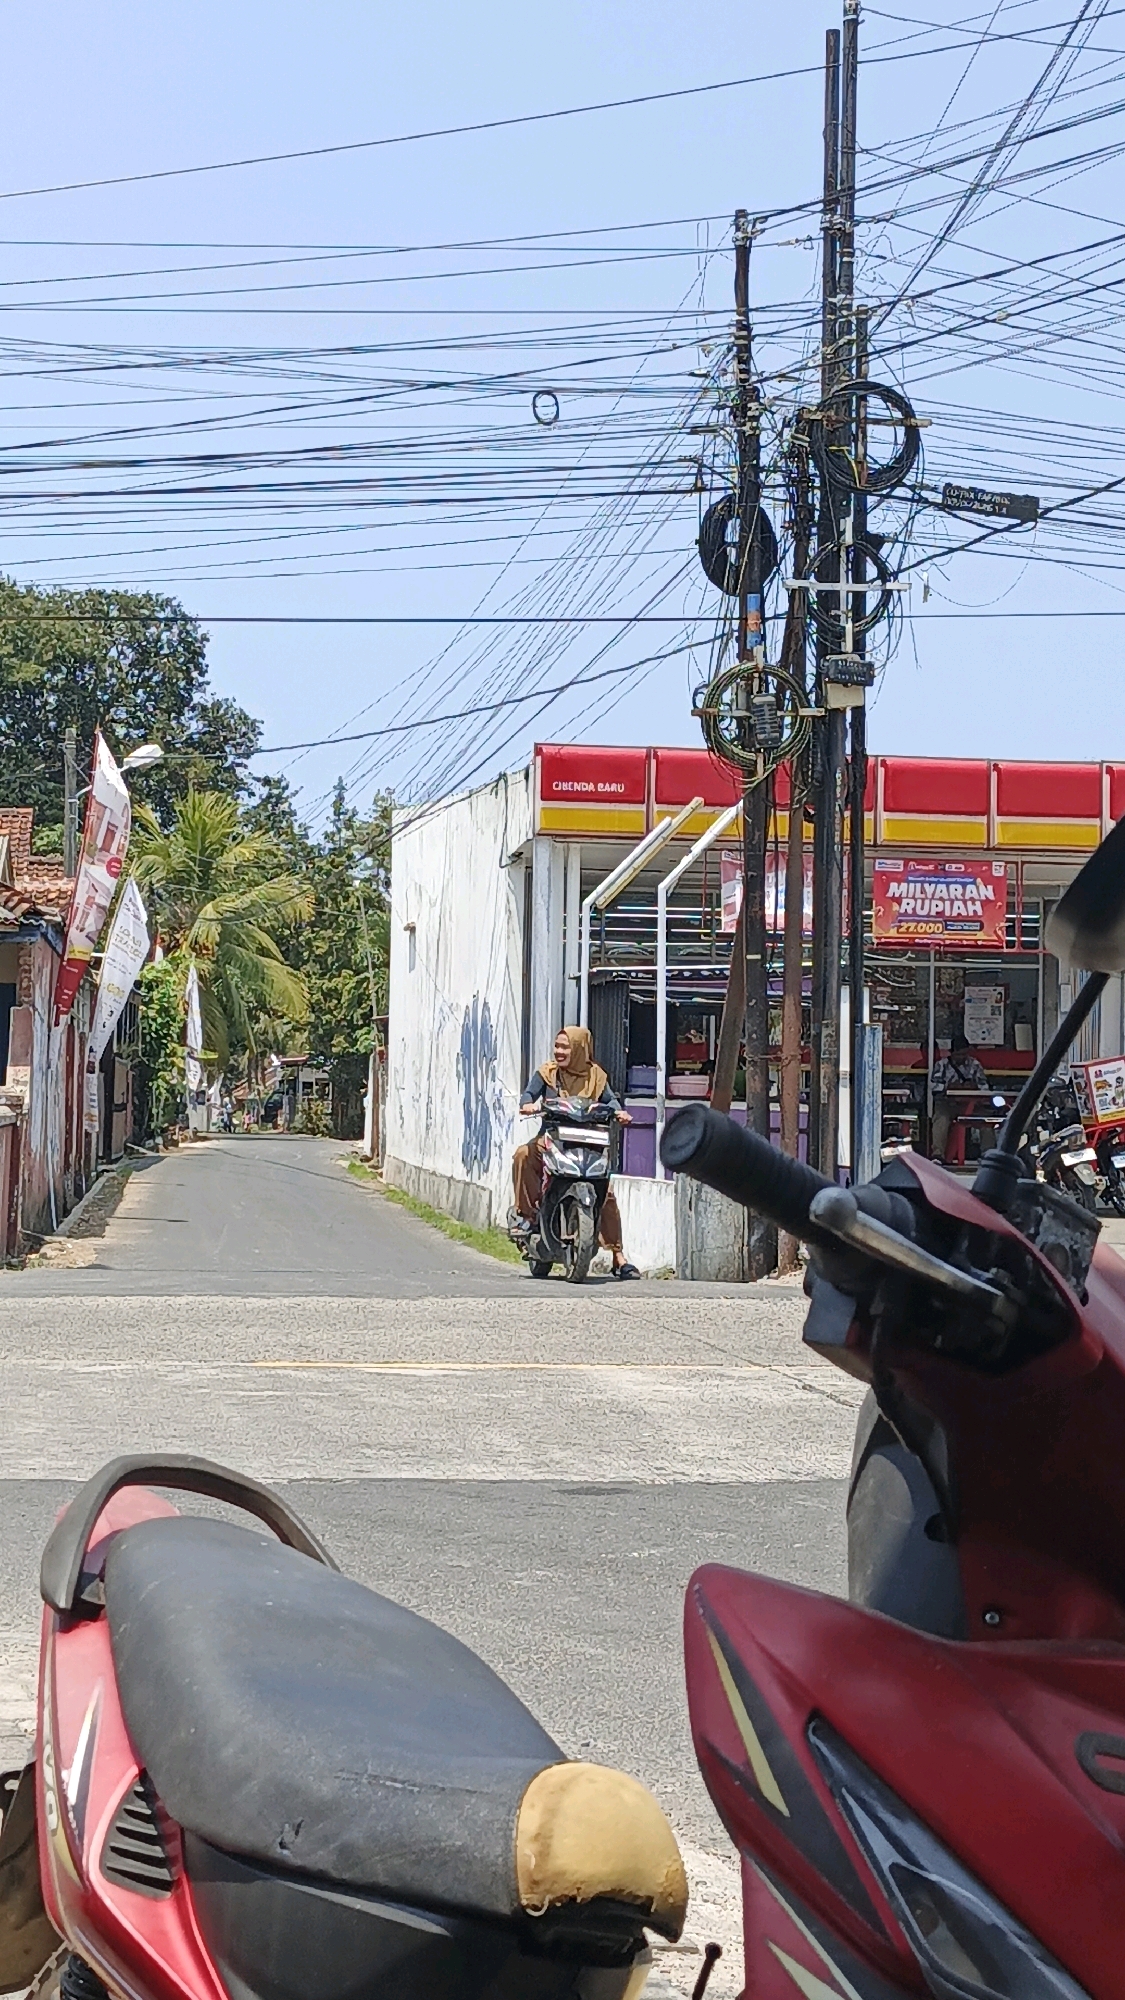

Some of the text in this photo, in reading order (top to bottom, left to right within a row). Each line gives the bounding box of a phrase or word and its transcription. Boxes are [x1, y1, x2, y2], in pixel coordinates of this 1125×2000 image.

[886, 882, 995, 900] MILYARAN
[899, 898, 983, 917] RUPIAH
[898, 922, 943, 934] 27.000
